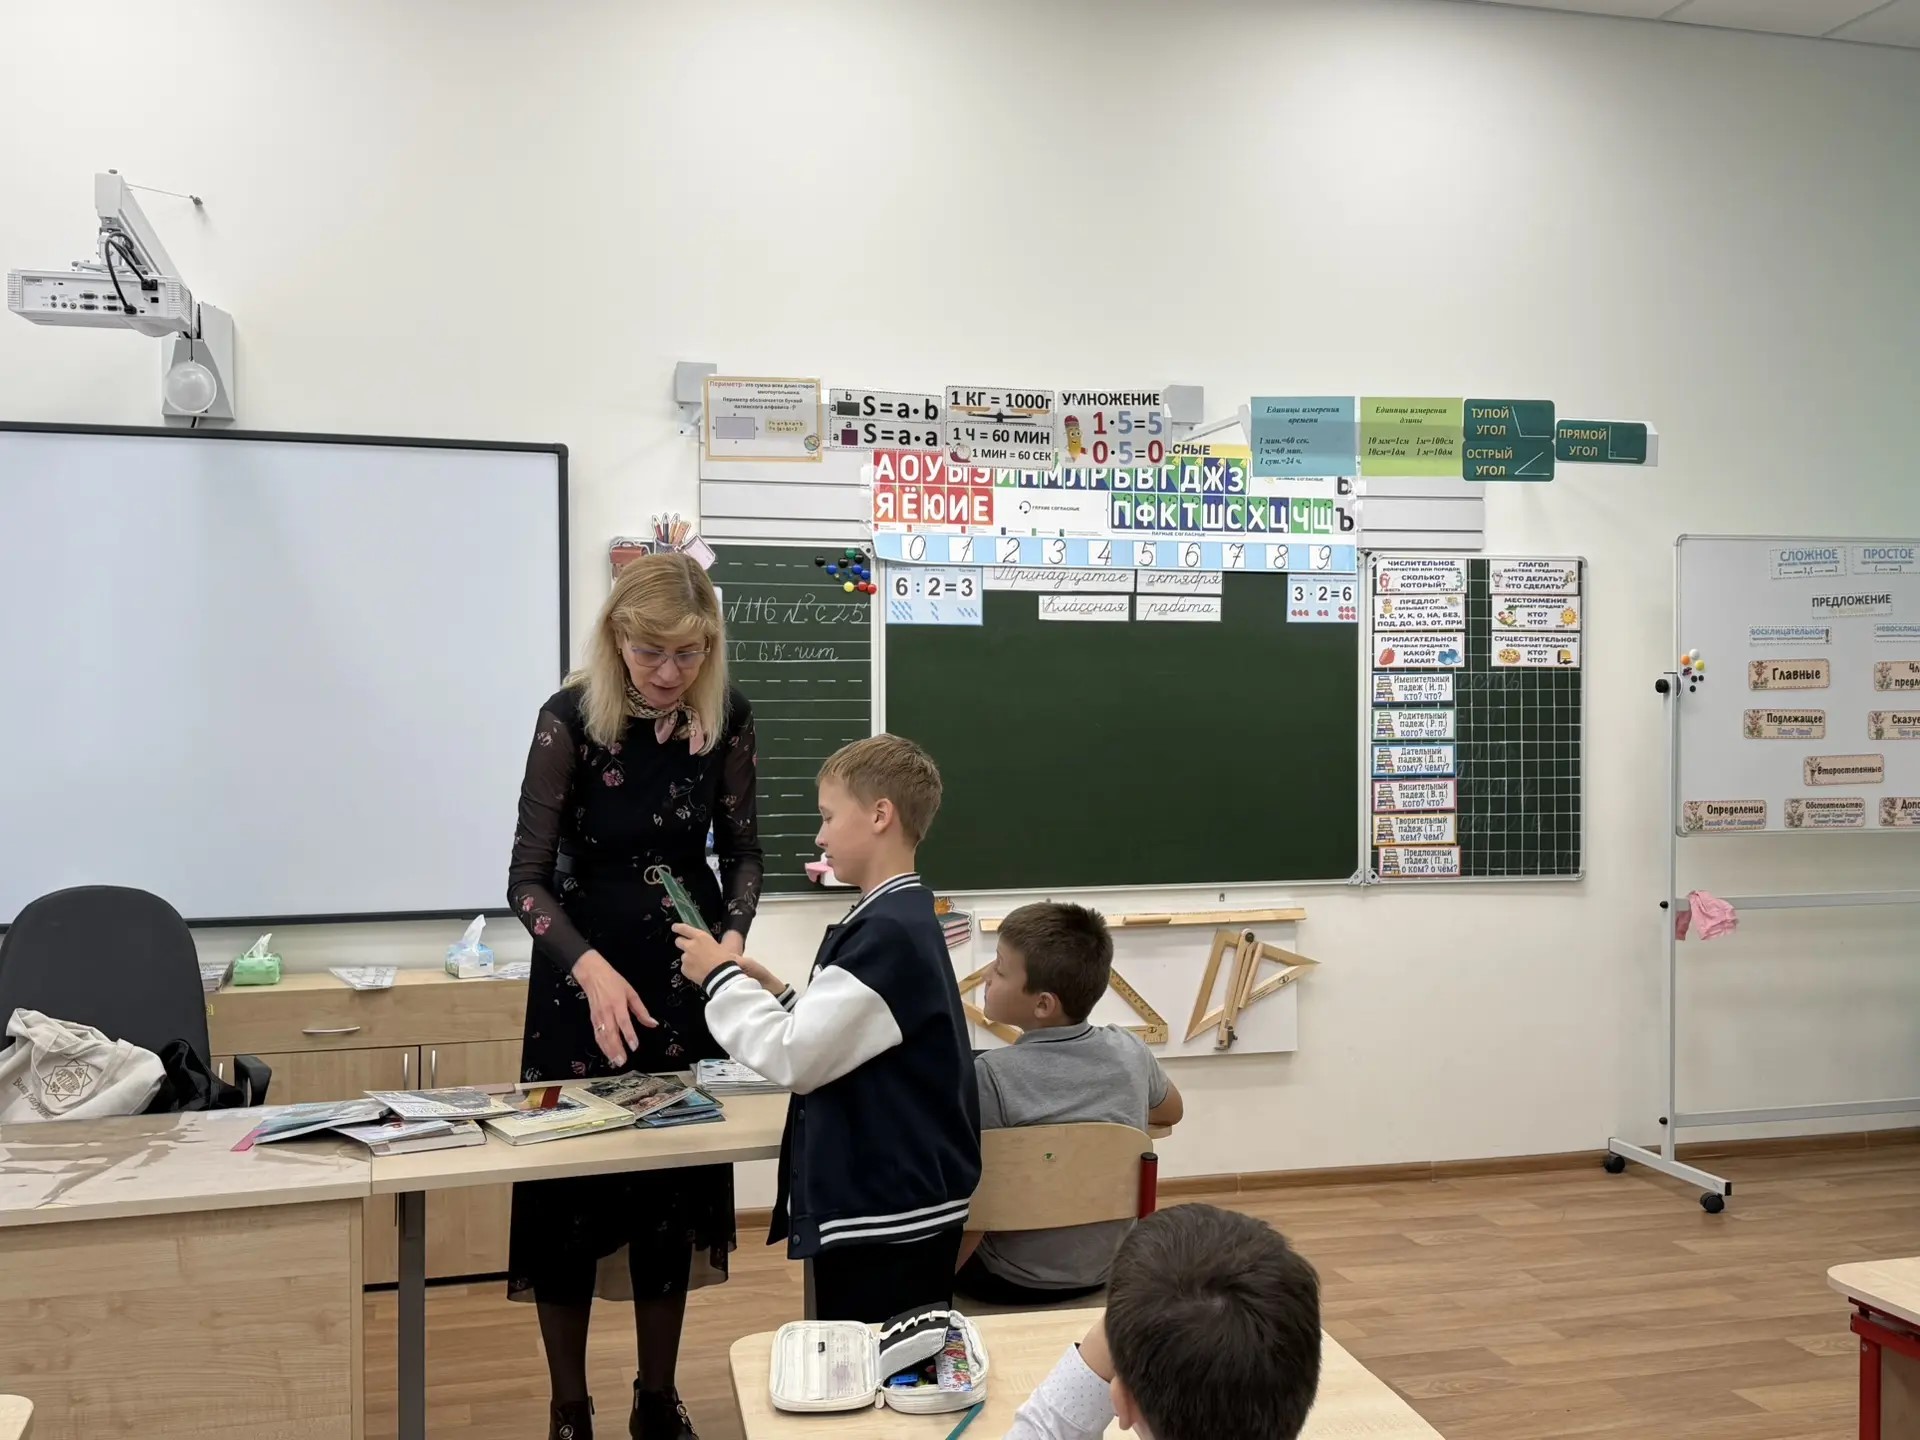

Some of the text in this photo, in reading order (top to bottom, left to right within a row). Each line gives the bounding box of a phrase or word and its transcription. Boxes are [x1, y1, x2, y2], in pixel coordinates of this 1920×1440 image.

[951, 391, 960, 405] 1
[966, 391, 986, 407] КГ
[1005, 393, 1052, 409] 1000г
[1062, 393, 1160, 406] УМНОЖЕНИЕ
[1266, 406, 1340, 415] Единицы измерения
[1375, 406, 1447, 415] Единицы измерения
[1471, 406, 1510, 419] ТУПОЙ
[1399, 417, 1423, 425] длины
[1476, 425, 1507, 436] УГОЛ
[1559, 427, 1608, 441] ПРЯМОЙ
[953, 428, 960, 440] 1
[966, 428, 975, 441] Ч
[992, 429, 1010, 443] 60
[1014, 430, 1051, 445] МИН
[972, 448, 1052, 461] 1 МИН 60 СЕК
[1466, 446, 1513, 460] ОСТРЫЙ
[1568, 446, 1598, 457] УГОЛ
[1475, 465, 1506, 476] УГОЛ
[909, 535, 1332, 570] 0 1 2 3 4 5 6 7 8 9
[1780, 549, 1838, 561] СЛОЖНОЕ
[1863, 549, 1914, 559] ПРОСТОЕ
[1812, 594, 1891, 608] ПРЕДЛОЖЕНИЕ
[1403, 648, 1435, 656] КАКОЙ?
[1394, 675, 1449, 683] Именительный
[1772, 667, 1821, 680] Главные
[1404, 692, 1442, 700] кто? что?
[1766, 713, 1823, 724] Подлежащее
[1425, 728, 1446, 736] чего?
[1397, 763, 1449, 773] кому? чему?
[1817, 765, 1882, 775] Второстепенные
[1706, 804, 1764, 815] Определение
[1395, 816, 1447, 824] Творительный
[1401, 832, 1444, 841] кем? чем?
[1404, 849, 1452, 857] Предложный
[1405, 857, 1428, 865] падеж
[1408, 865, 1429, 873] ком?
